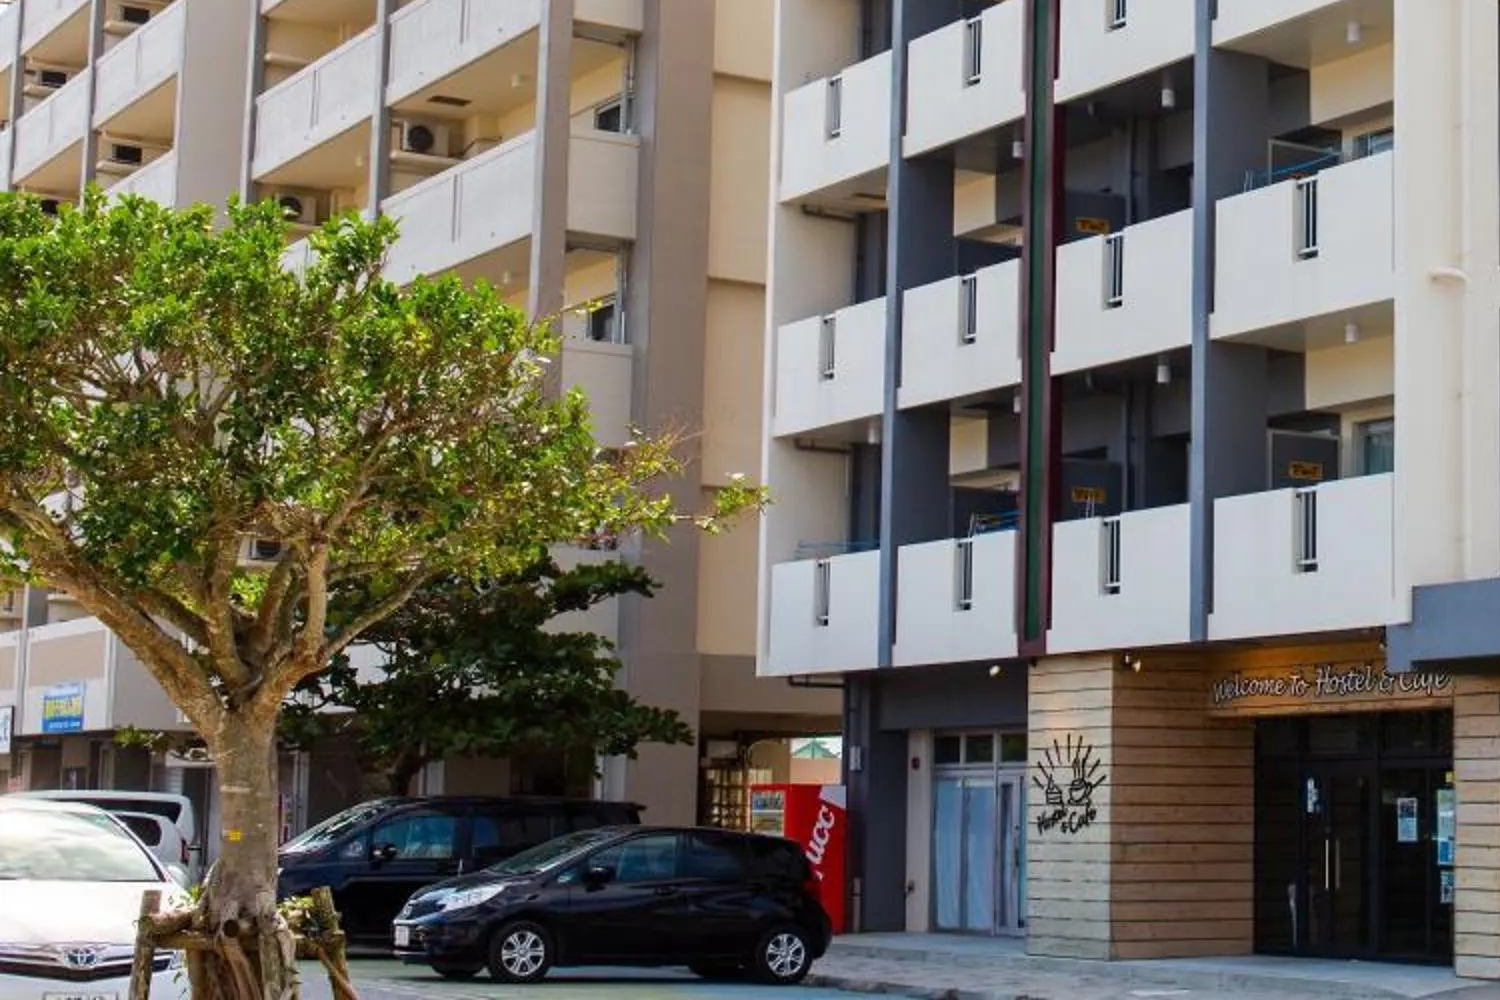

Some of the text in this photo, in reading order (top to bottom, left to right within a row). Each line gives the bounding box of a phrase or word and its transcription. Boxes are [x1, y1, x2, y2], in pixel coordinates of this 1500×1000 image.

[1213, 674, 1285, 702] Welcome
[1315, 664, 1374, 697] Hostel
[1379, 669, 1395, 693] &
